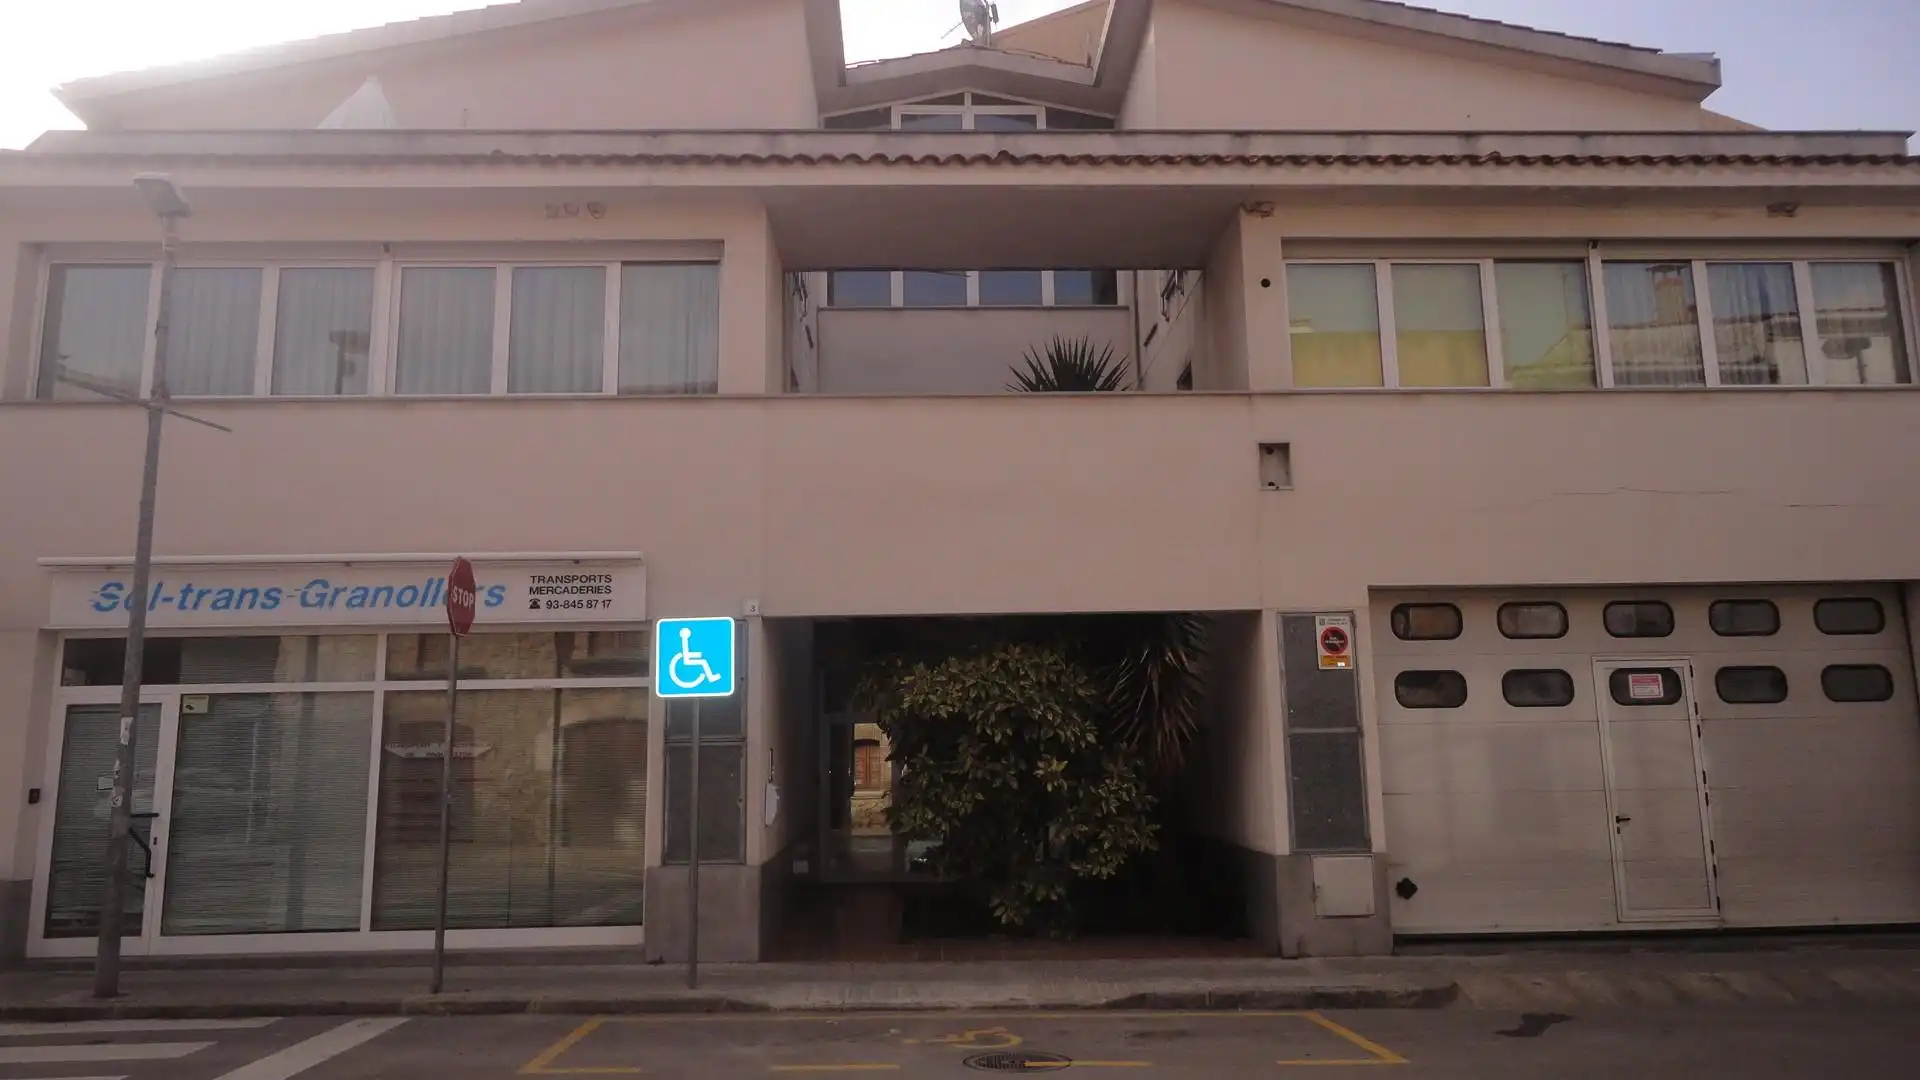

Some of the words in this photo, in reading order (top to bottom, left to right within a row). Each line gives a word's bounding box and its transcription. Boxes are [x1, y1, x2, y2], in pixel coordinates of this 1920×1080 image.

[530, 574, 612, 584] TRANSPORTS
[300, 577, 507, 610] Granolls
[529, 585, 612, 595] MERCADERIES
[452, 585, 474, 610] STOP
[545, 599, 583, 610] 93-845
[586, 599, 599, 610] 87
[601, 599, 612, 610] 17
